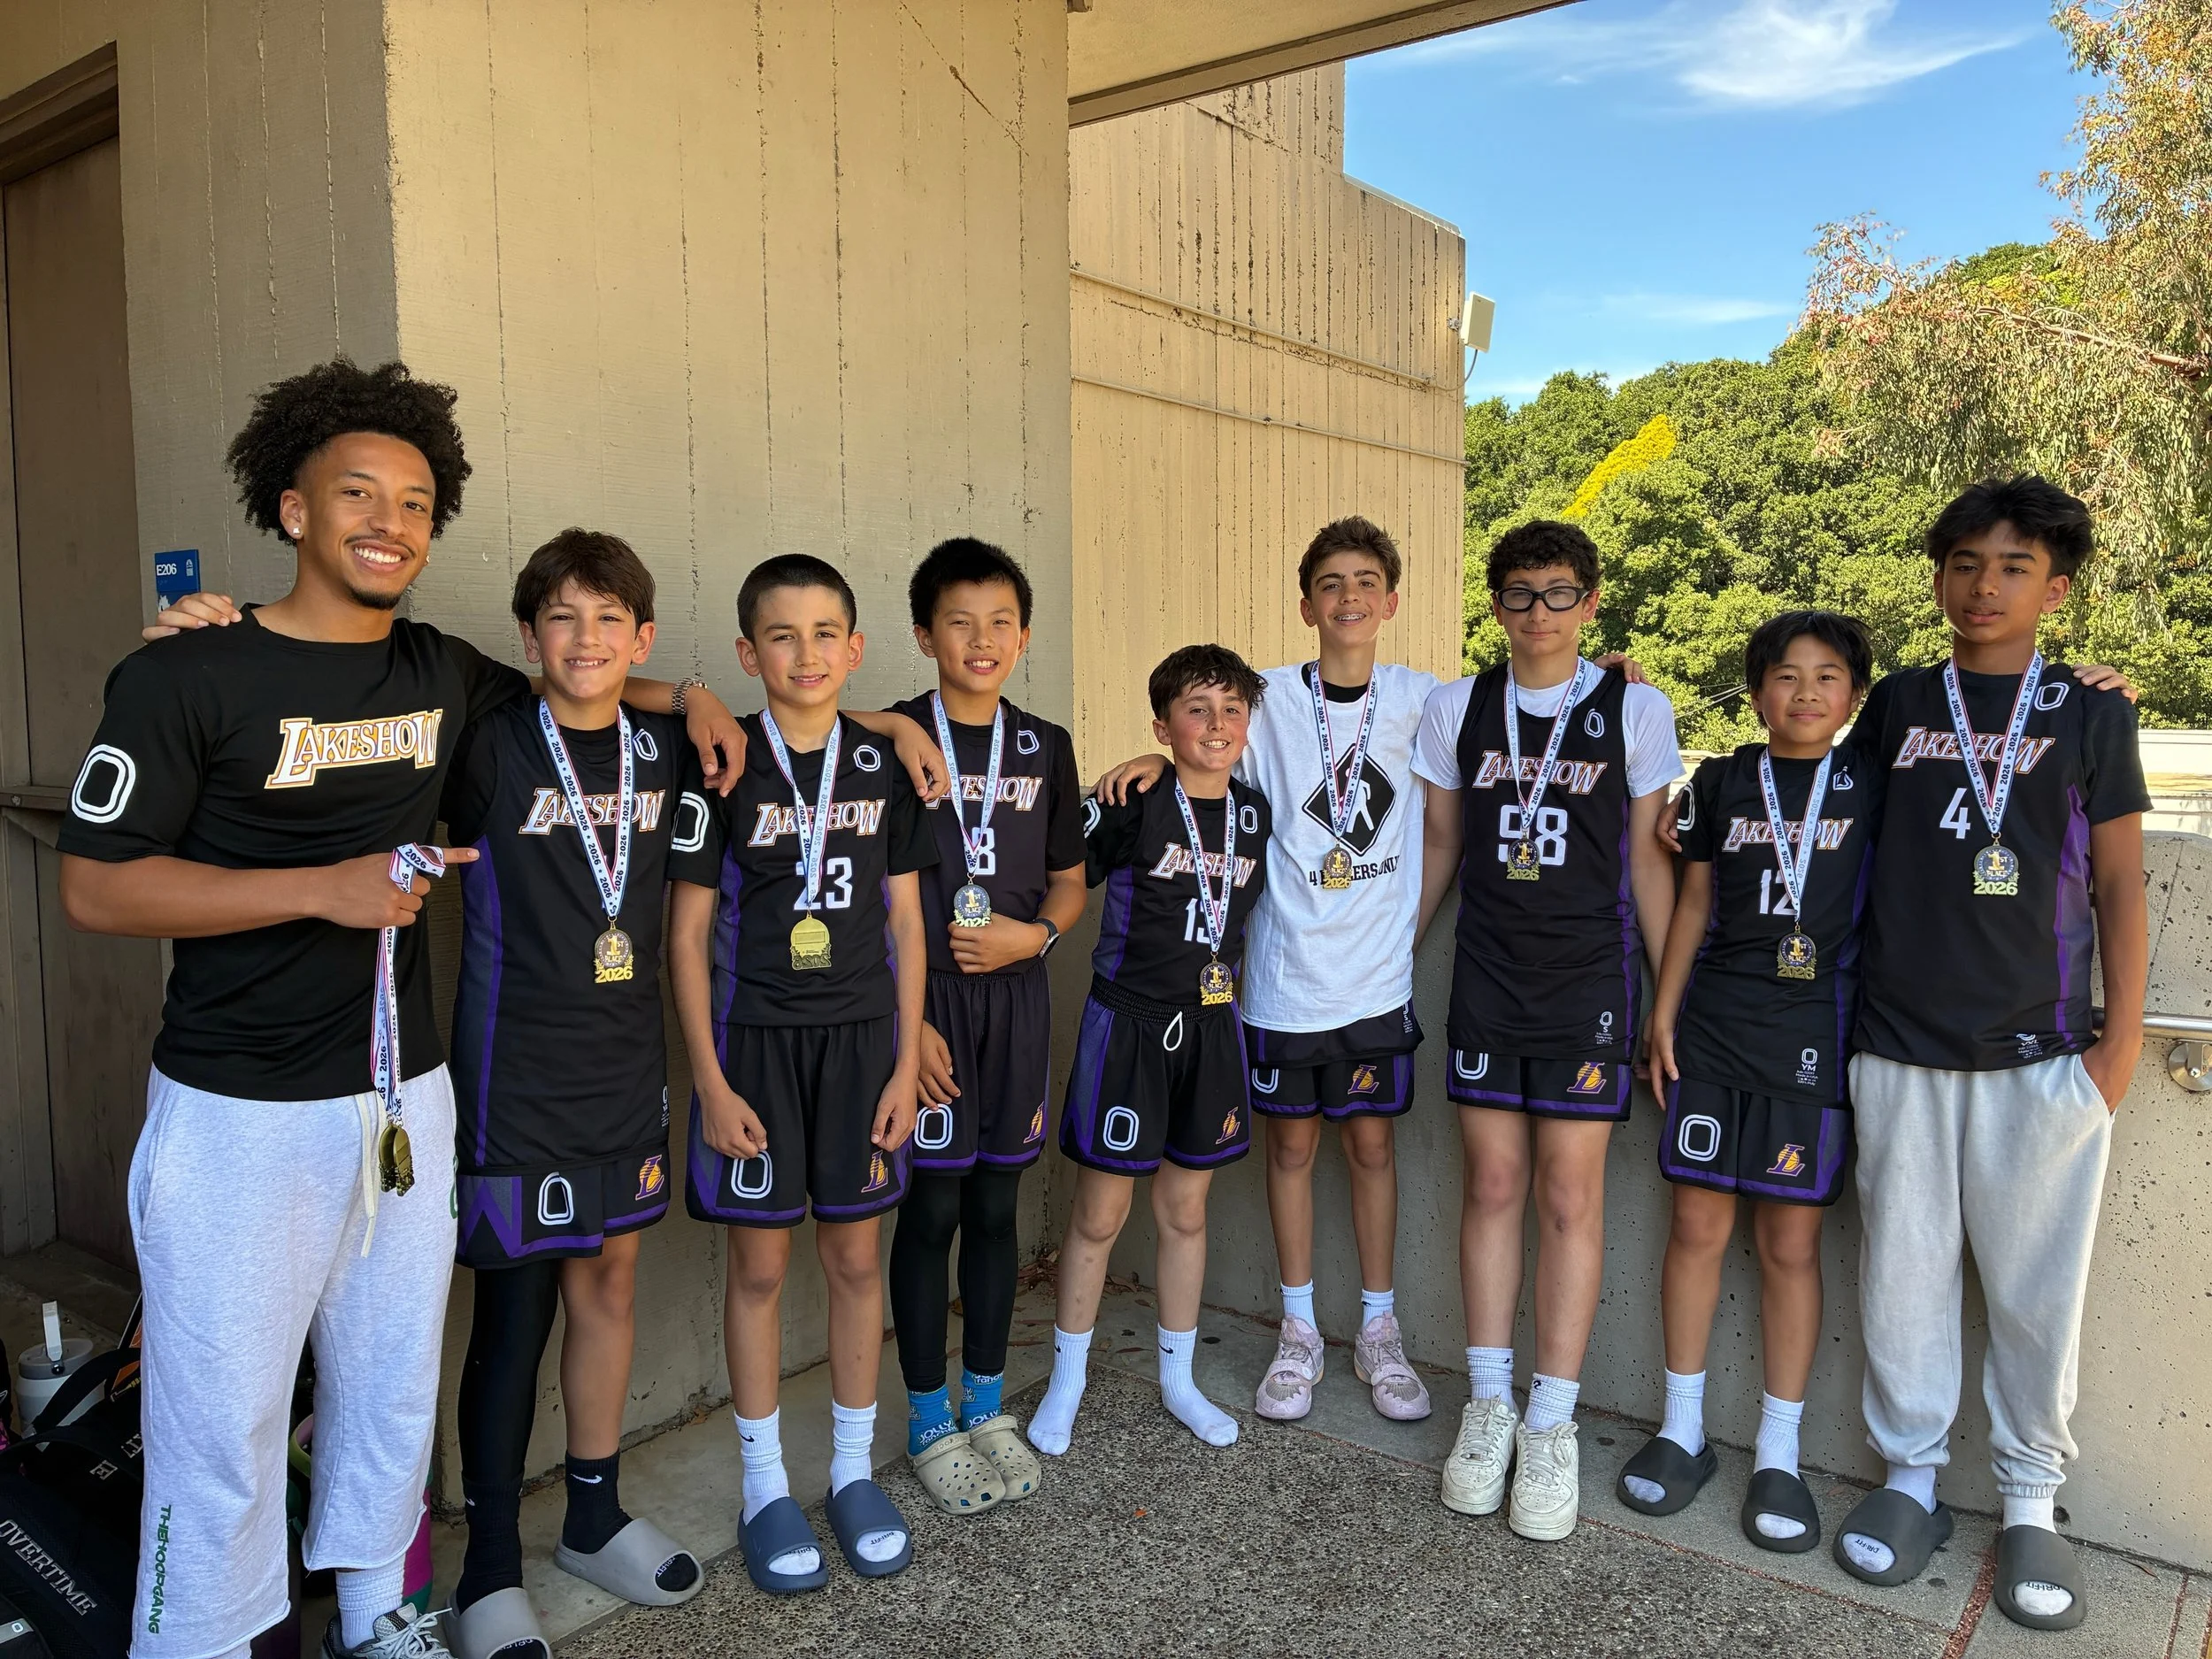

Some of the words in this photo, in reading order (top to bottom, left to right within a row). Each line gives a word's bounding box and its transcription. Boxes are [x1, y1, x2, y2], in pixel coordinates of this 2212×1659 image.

[157, 564, 177, 576] E206
[265, 709, 442, 789] LAKESHOW
[1532, 787, 1541, 804] 2026
[1541, 760, 1551, 778] 2026
[1551, 733, 1561, 750] 2026
[1560, 705, 1571, 723] 2026
[1571, 680, 1581, 697] 2026
[1946, 672, 1955, 690] 2026
[1951, 699, 1962, 719] 2026
[1959, 727, 1970, 749] 2026
[1968, 757, 1980, 779] 2026
[1977, 787, 1987, 809] 2026
[1993, 796, 2003, 818] 2026
[2000, 764, 2011, 785] 2026
[2008, 732, 2019, 752] 2026
[2016, 702, 2027, 722] 2026
[2024, 675, 2036, 693] 2026
[926, 775, 1042, 810] ESOW
[1338, 817, 1347, 833] 2026
[1345, 789, 1354, 808] 2026
[1351, 762, 1360, 780] 2026
[541, 710, 553, 730] 2026
[552, 741, 565, 764] 2026
[564, 775, 577, 797] 2026
[576, 809, 590, 832] 2026
[588, 843, 601, 865] 2026
[600, 877, 612, 899] 2026
[798, 804, 807, 826] 2026
[1939, 787, 1970, 839] 4
[748, 799, 886, 847] LAKHOW
[1774, 821, 1784, 841] 2026
[1175, 787, 1186, 805] 2026
[1185, 814, 1194, 832] 2026
[1199, 870, 1208, 888] 2026
[1498, 804, 1568, 866] 98
[405, 849, 426, 869] 2026
[1148, 842, 1256, 888] LAKSHW
[1780, 850, 1792, 870] 2026
[614, 870, 624, 892] 2026
[794, 856, 853, 910] 23
[1310, 871, 1317, 887] 4
[1323, 878, 1352, 889] 2026
[1506, 869, 1540, 881] 2026
[1789, 880, 1798, 899] 2026
[1973, 881, 2018, 896] 2026
[956, 918, 991, 928] 2026
[595, 966, 634, 984] 2026
[1777, 965, 1816, 980] 2026
[1202, 992, 1233, 1005] 2026
[969, 1409, 998, 1428] JOLLY
[919, 1420, 951, 1444] JOLLY
[0, 1519, 97, 1616] OVERTIME
[148, 1504, 172, 1634] THEHOOPGANG
